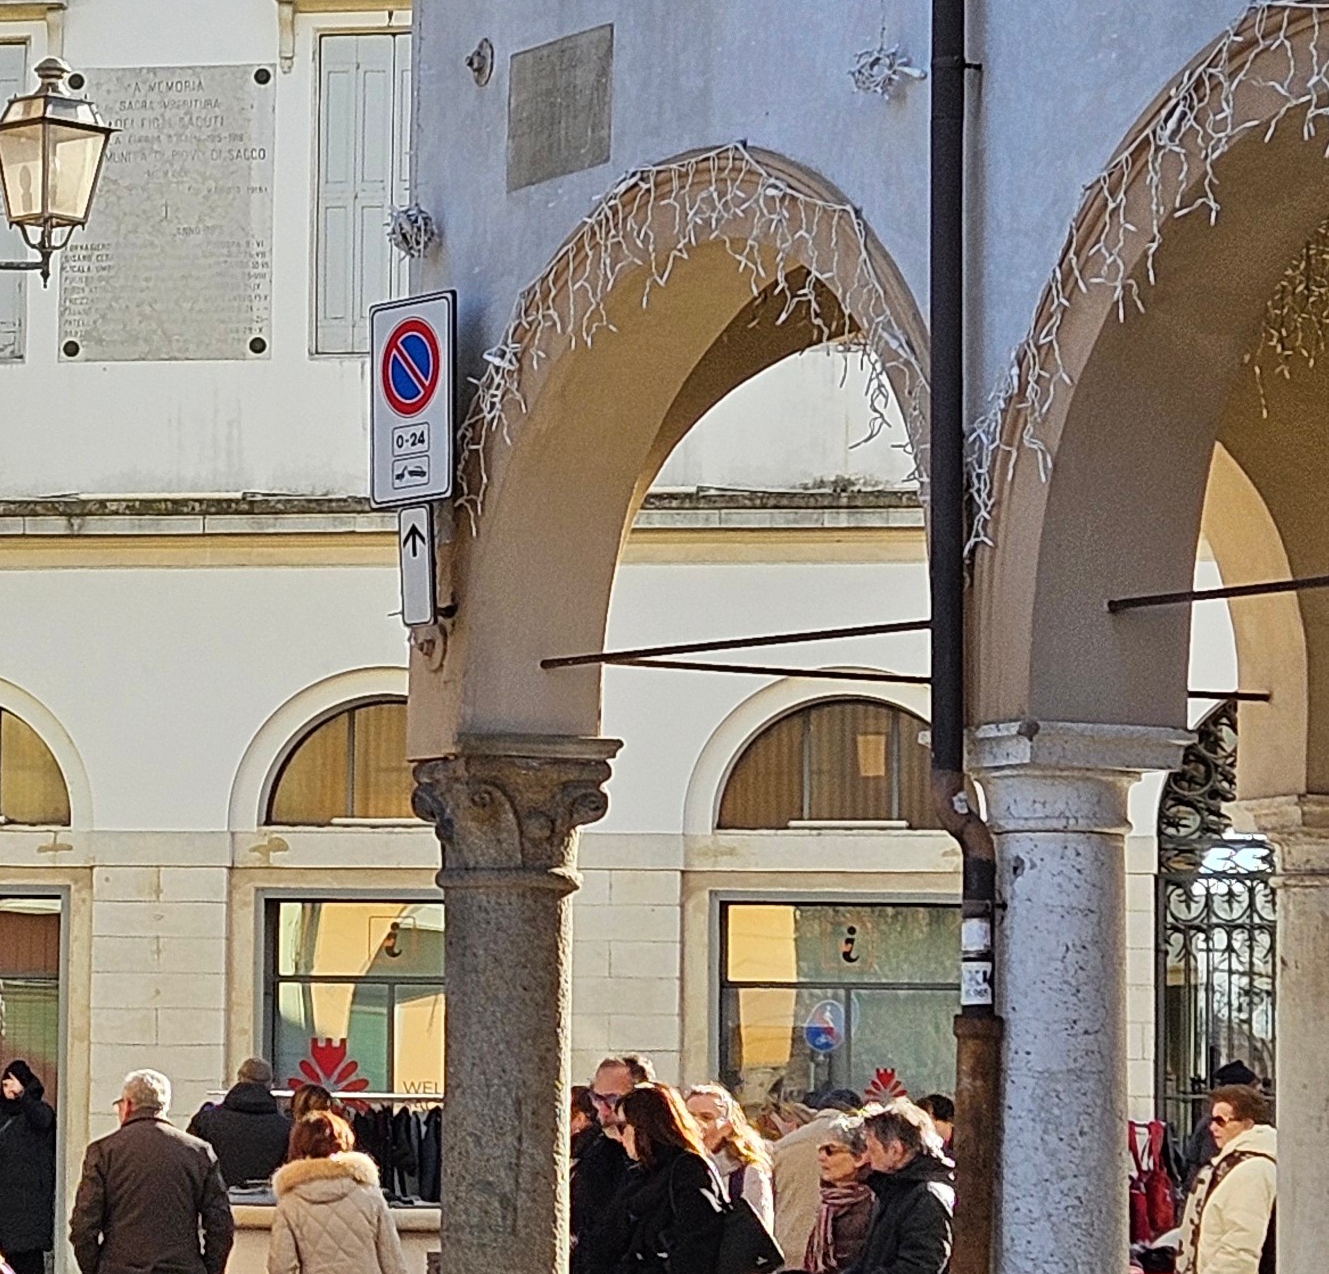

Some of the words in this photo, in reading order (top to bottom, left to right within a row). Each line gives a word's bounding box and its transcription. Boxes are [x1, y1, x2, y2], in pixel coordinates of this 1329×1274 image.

[228, 147, 266, 162] SACCO
[395, 430, 426, 449] 0-24
[402, 1080, 442, 1094] WEL
